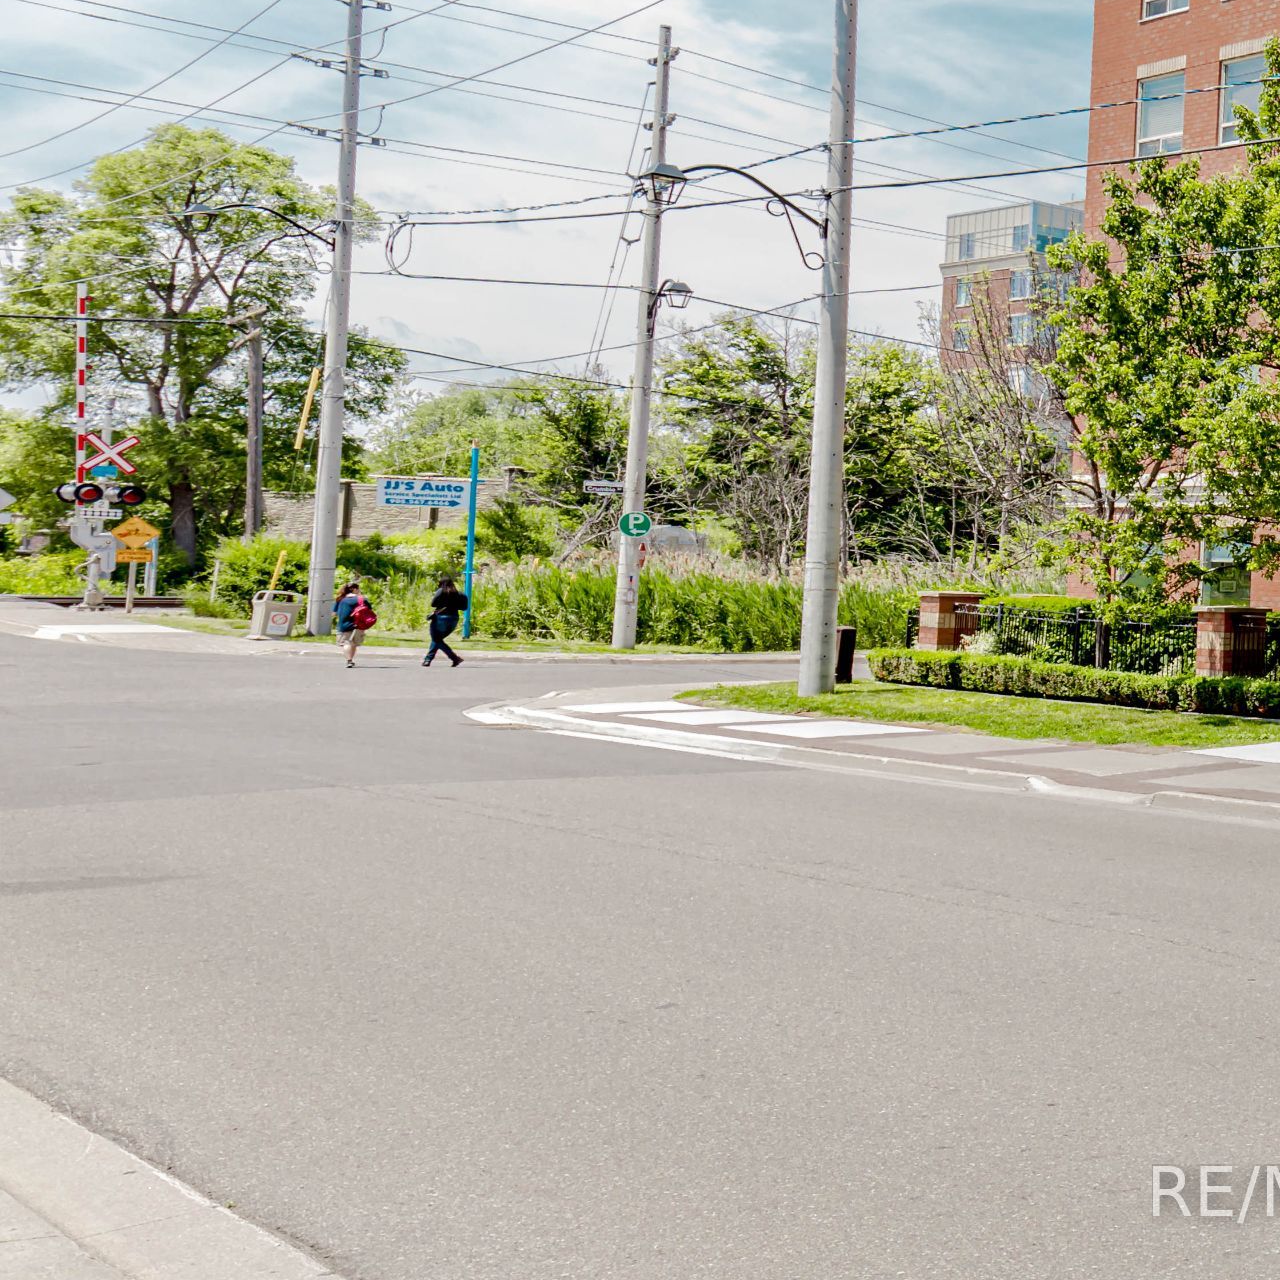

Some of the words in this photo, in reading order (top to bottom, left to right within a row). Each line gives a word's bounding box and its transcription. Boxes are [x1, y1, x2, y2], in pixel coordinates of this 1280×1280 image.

[384, 481, 414, 490] JJ'S
[420, 482, 464, 493] Auto
[629, 514, 644, 529] P
